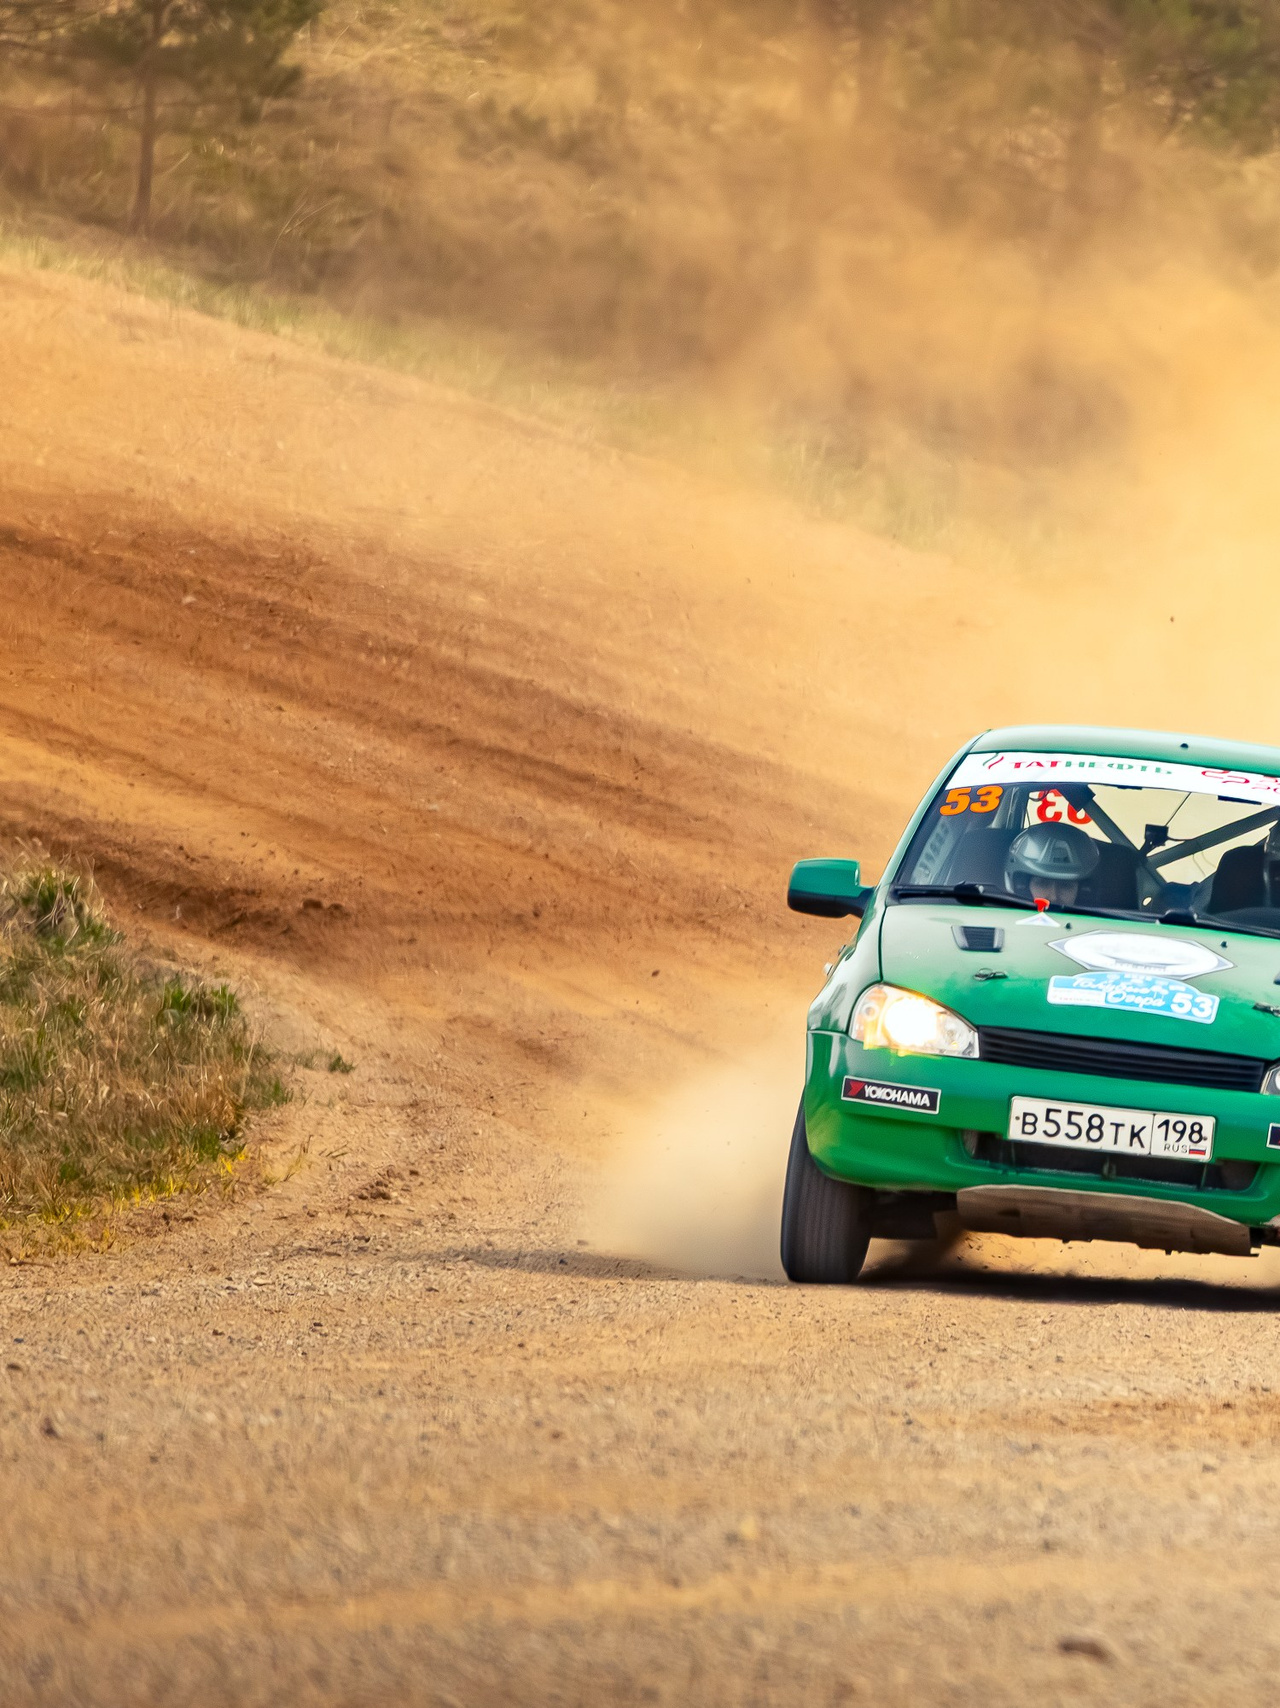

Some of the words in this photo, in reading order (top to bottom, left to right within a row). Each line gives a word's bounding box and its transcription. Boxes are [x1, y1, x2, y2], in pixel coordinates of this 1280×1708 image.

[1009, 761, 1172, 775] ТАТНЕФТЬ
[940, 785, 1003, 816] 53
[1170, 992, 1212, 1018] 53
[864, 1084, 930, 1107] YOKOHAMA
[1157, 1119, 1204, 1144] 198
[1164, 1143, 1188, 1154] RUS
